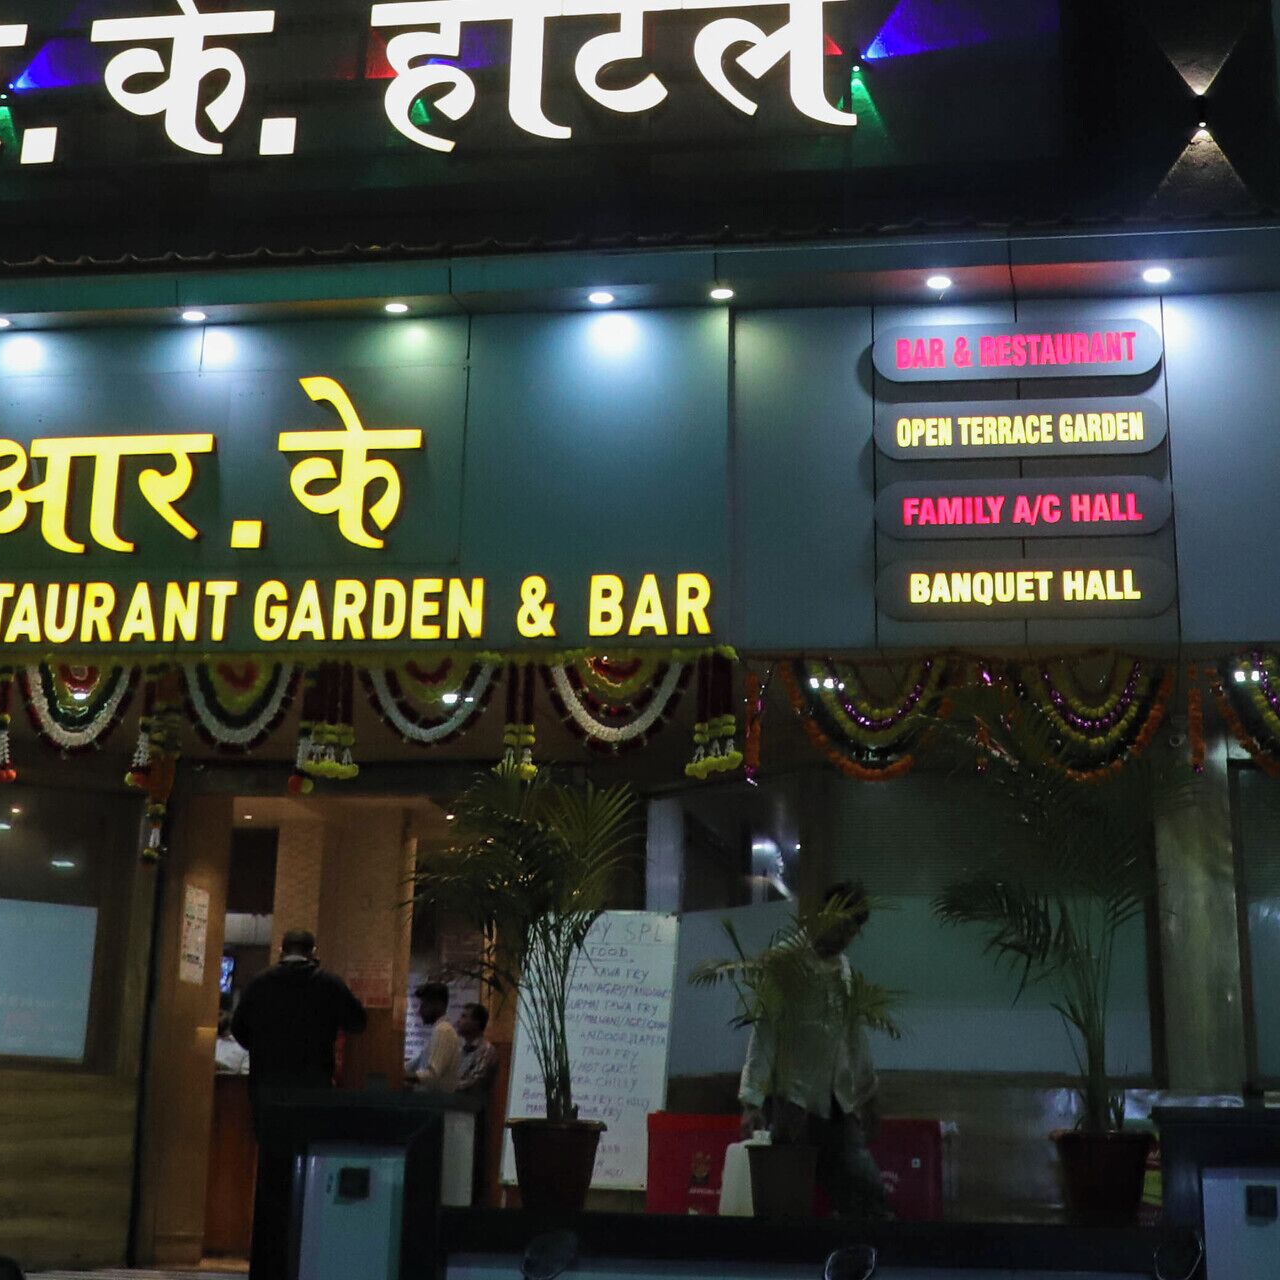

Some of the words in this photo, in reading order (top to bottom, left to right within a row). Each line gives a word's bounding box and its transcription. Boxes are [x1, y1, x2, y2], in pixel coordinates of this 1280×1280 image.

[895, 338, 946, 370] BAR
[953, 336, 972, 368] &
[979, 331, 1137, 366] RESTAURANT
[896, 417, 952, 447] OPEN
[958, 414, 1053, 446] TERRACE
[1058, 412, 1144, 443] GARDEN
[902, 496, 1005, 525] FAMILY
[1012, 494, 1062, 526] A/C
[1070, 493, 1143, 521] HALL
[910, 571, 1053, 605] BANQUET
[1062, 569, 1141, 600] HALL
[253, 577, 484, 642] GARDEN
[518, 575, 556, 638] &
[588, 572, 713, 637] BAR
